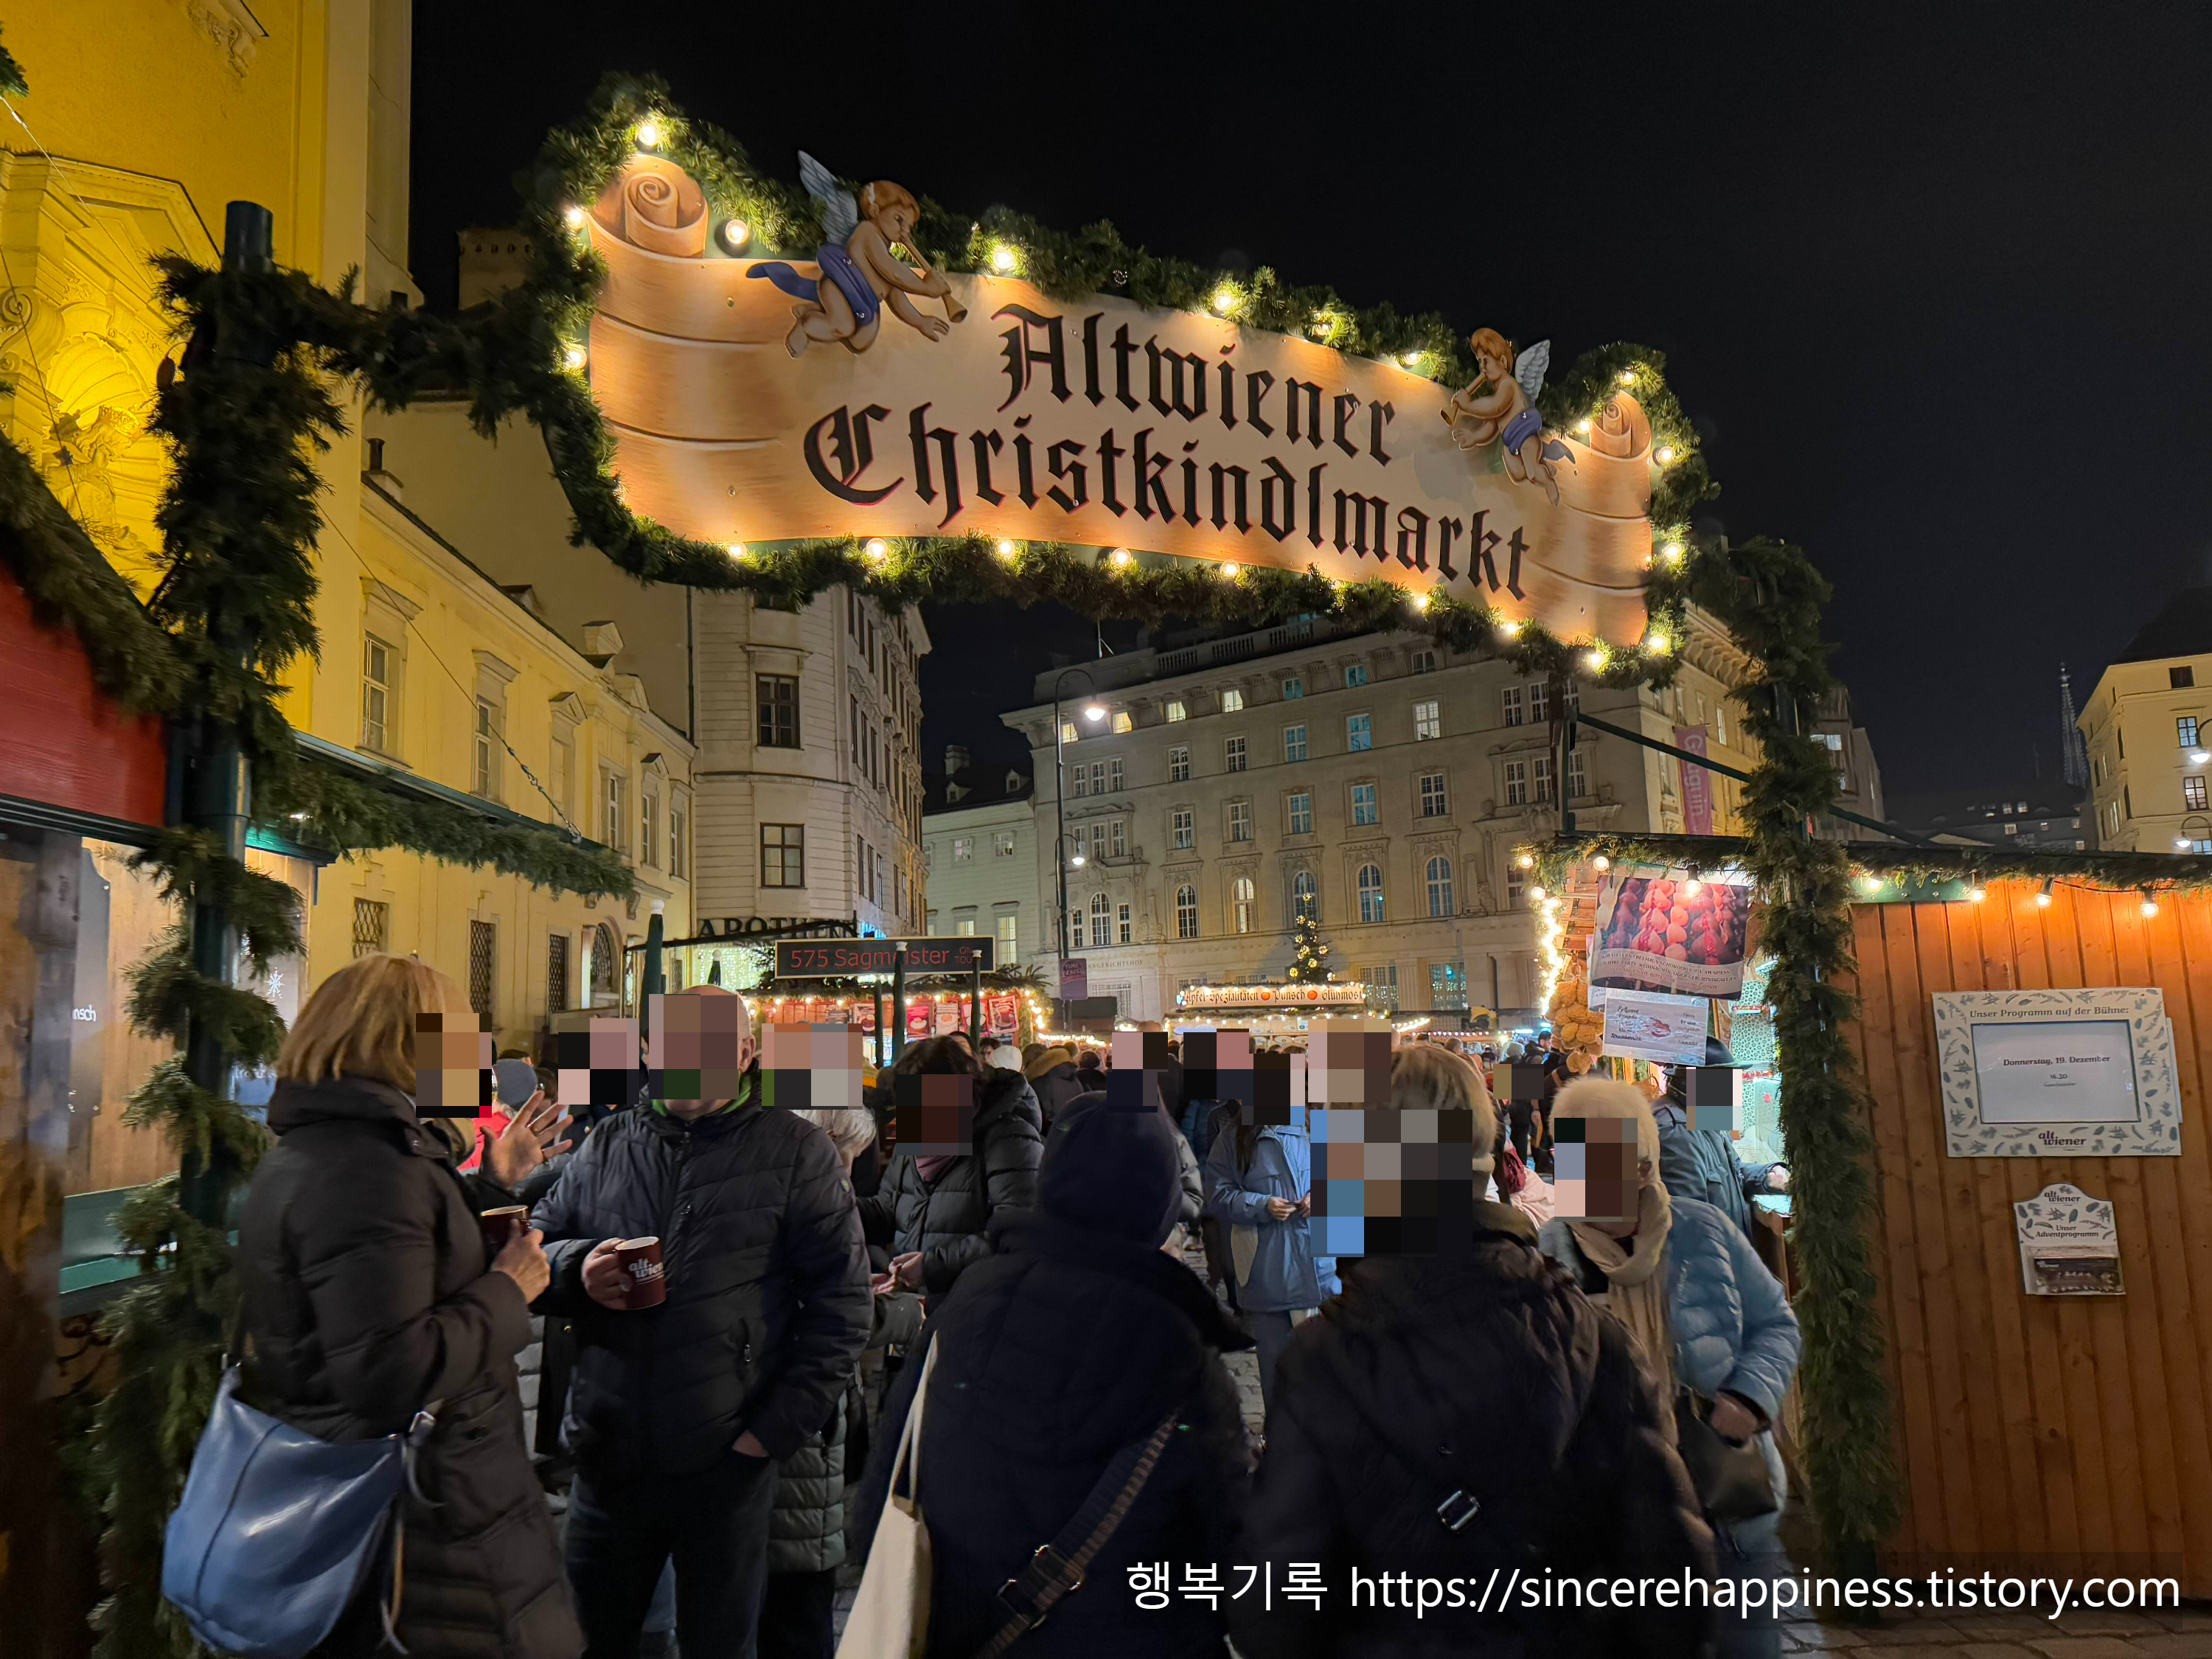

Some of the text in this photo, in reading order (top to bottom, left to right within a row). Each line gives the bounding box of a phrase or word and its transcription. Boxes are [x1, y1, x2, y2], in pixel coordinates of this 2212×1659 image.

[991, 303, 1395, 467] Altwiener
[804, 402, 1528, 601] Christkindlmarkt
[1684, 734, 1707, 816] Guguin
[790, 949, 828, 968] 575
[834, 945, 950, 971] Sagmister
[1088, 960, 1143, 969] GSGERICHTSHOF
[1273, 989, 1305, 1003] Punsch
[72, 1007, 97, 1022] nsch
[1970, 1006, 2129, 1018] Unser Programm auf der Bühne:
[2003, 1058, 2053, 1066] Donnerstag,
[2069, 1055, 2111, 1063] Dezember
[2043, 1135, 2087, 1146] wiener
